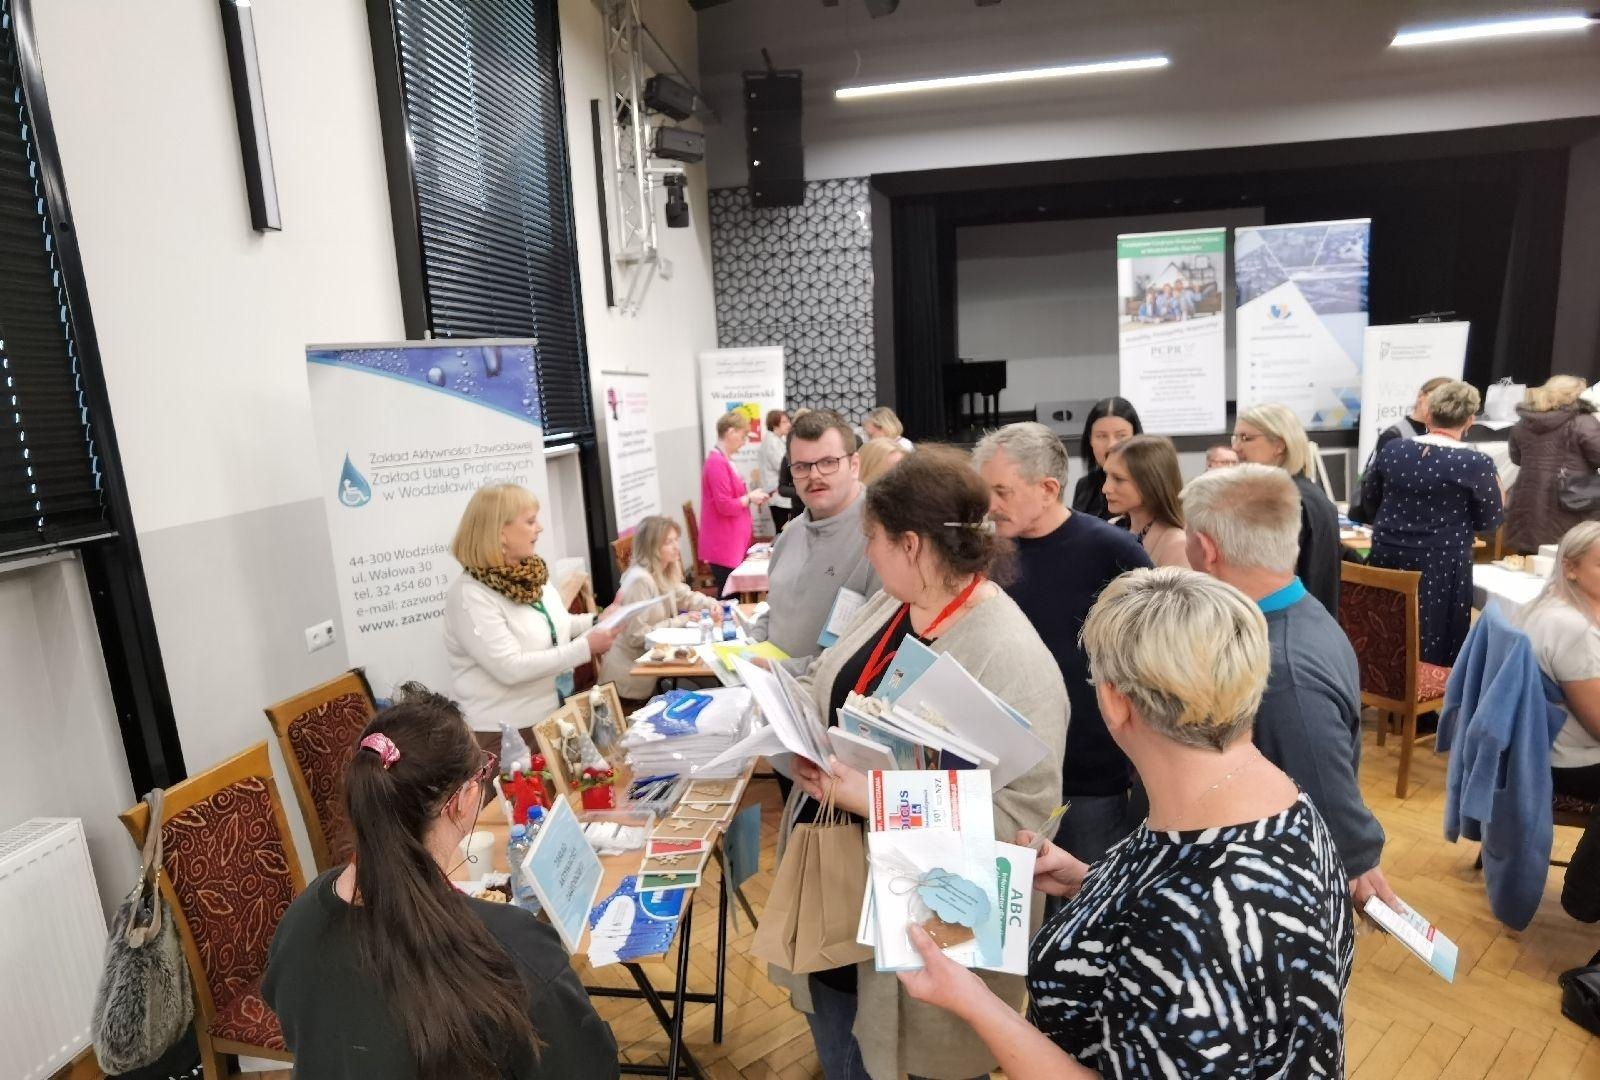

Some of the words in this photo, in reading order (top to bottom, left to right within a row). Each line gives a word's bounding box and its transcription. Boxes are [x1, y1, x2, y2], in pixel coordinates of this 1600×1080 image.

[369, 451, 409, 464] Zakład
[371, 469, 419, 486] Zakład
[423, 465, 460, 478] Usług
[463, 458, 534, 475] Pralniczych
[382, 490, 395, 500] w
[349, 552, 391, 567] 44-300
[352, 572, 367, 584] ul.
[418, 561, 432, 572] 30
[354, 588, 373, 600] tel.
[376, 585, 390, 597] 32
[393, 580, 414, 592] 454
[418, 577, 432, 588] 60
[435, 574, 448, 584] 13
[1009, 888, 1024, 928] ABC
